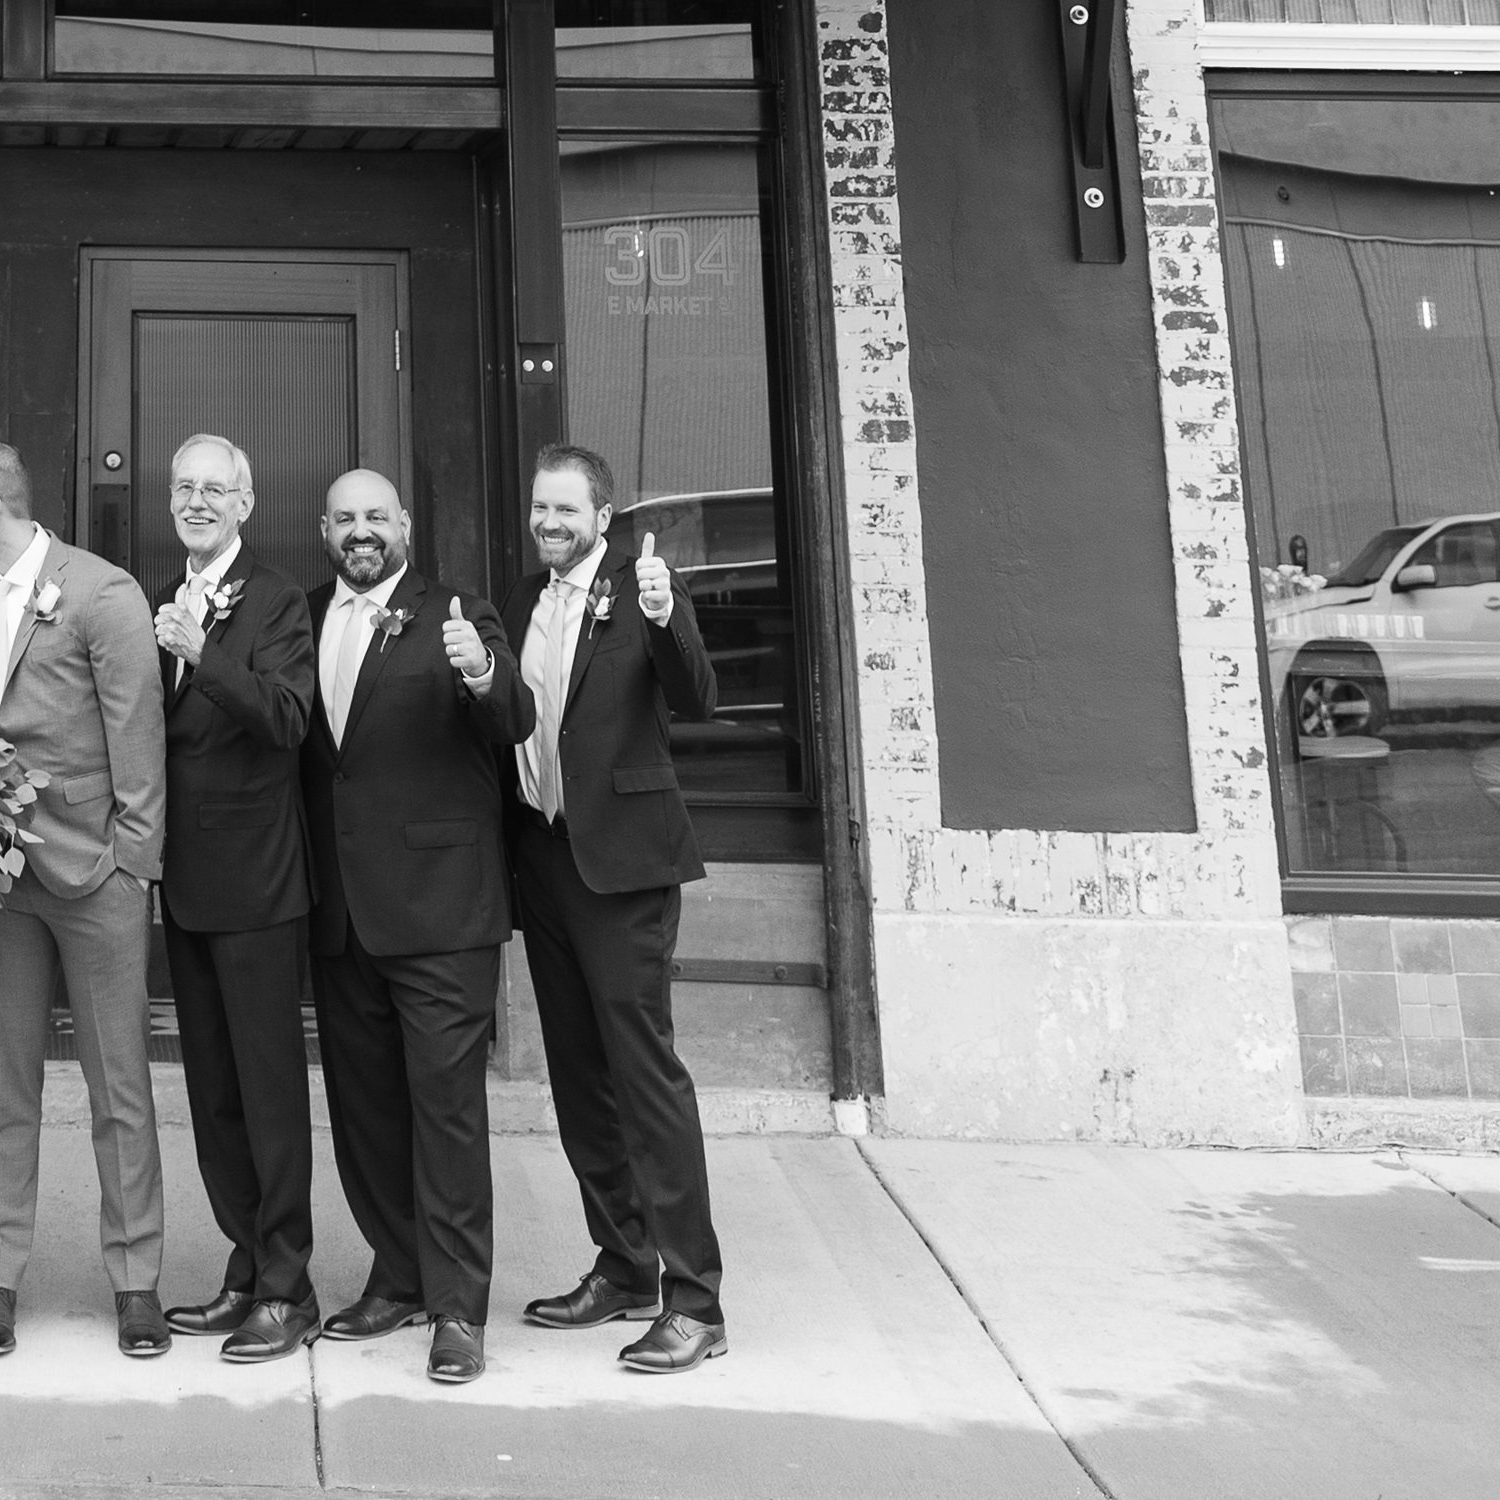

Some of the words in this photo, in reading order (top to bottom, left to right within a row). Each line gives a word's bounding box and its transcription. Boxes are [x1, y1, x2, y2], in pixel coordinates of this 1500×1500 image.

[603, 226, 742, 286] 304
[609, 296, 621, 315] E
[626, 296, 713, 315] MARKET
